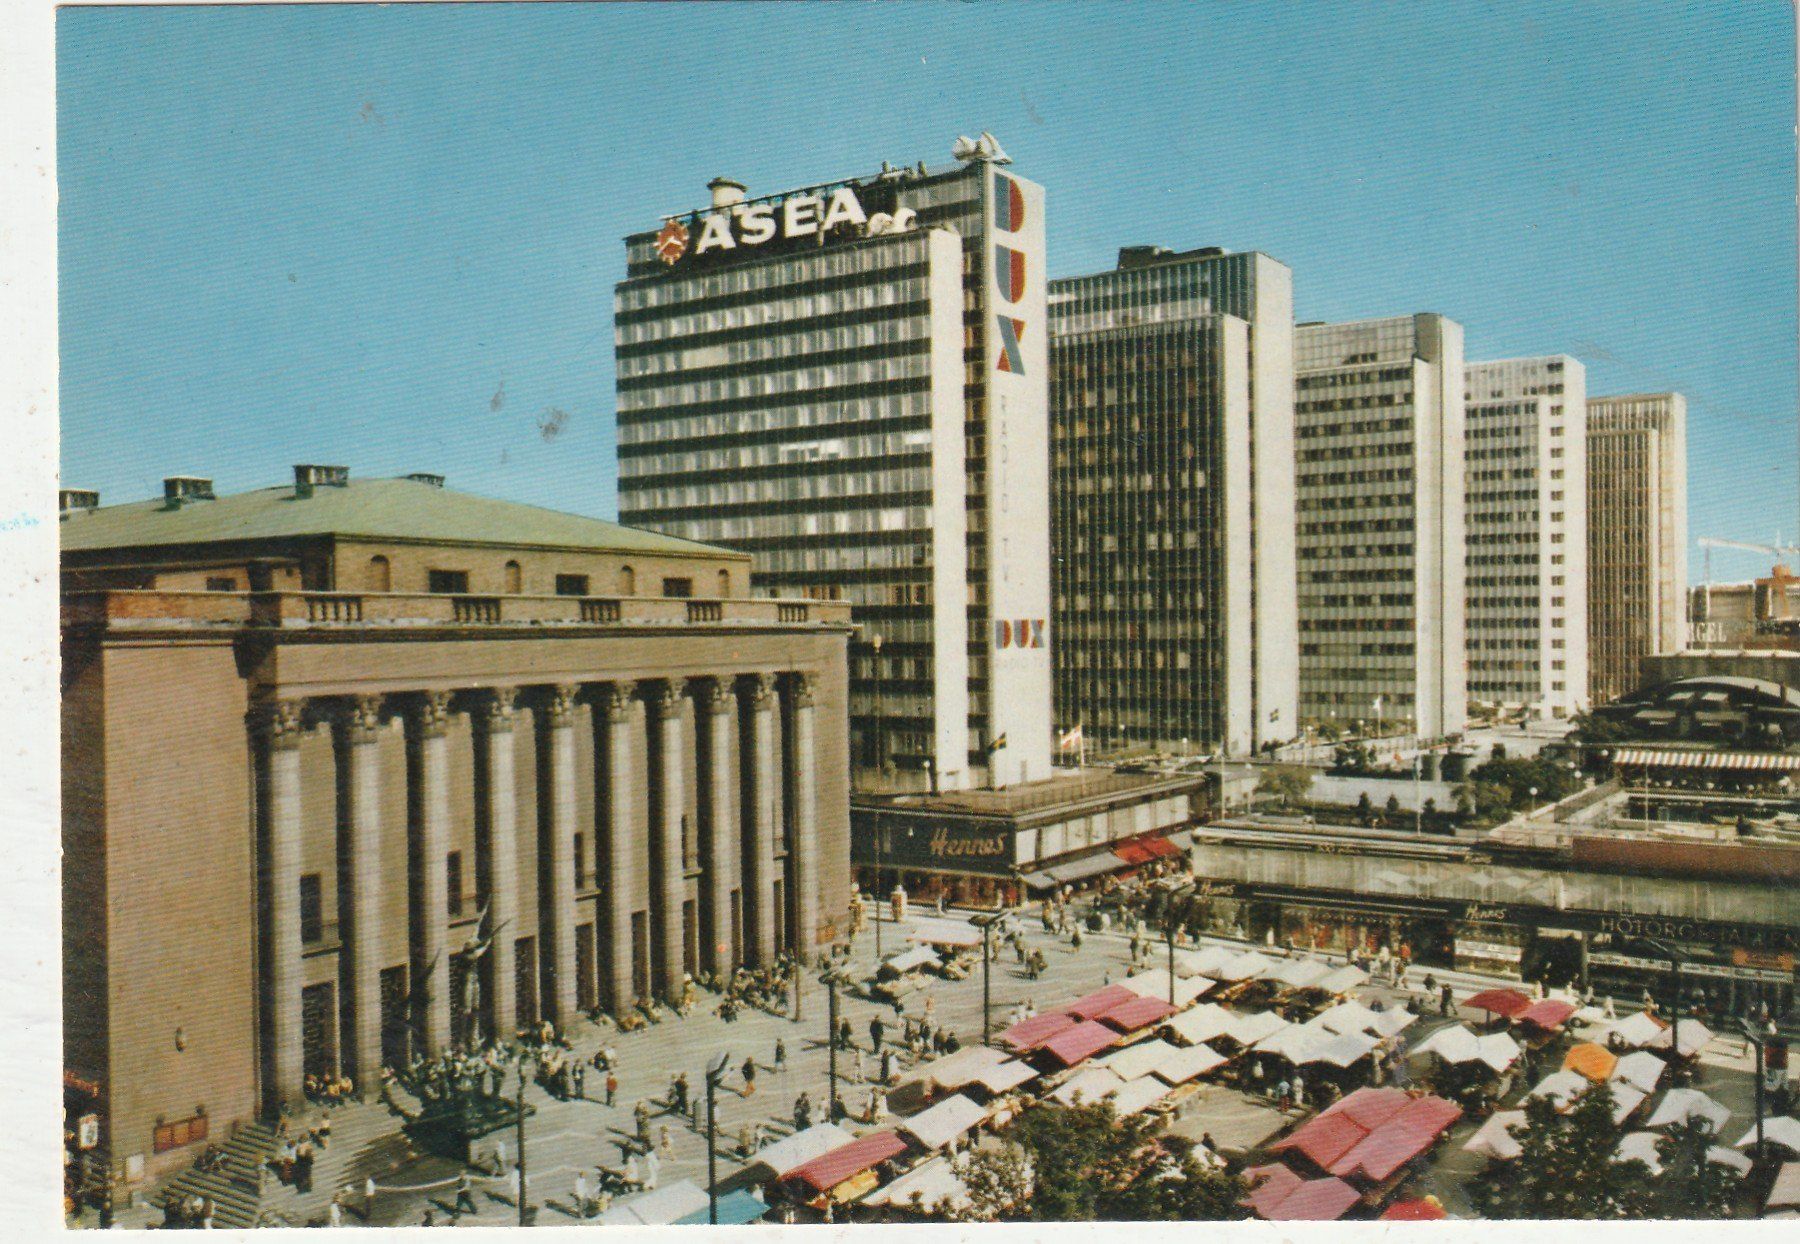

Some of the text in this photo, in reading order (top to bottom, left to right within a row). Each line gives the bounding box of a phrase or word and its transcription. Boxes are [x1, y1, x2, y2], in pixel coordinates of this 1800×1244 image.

[696, 187, 867, 255] ASEA
[994, 172, 1026, 376] DUX
[995, 619, 1044, 650] DUX
